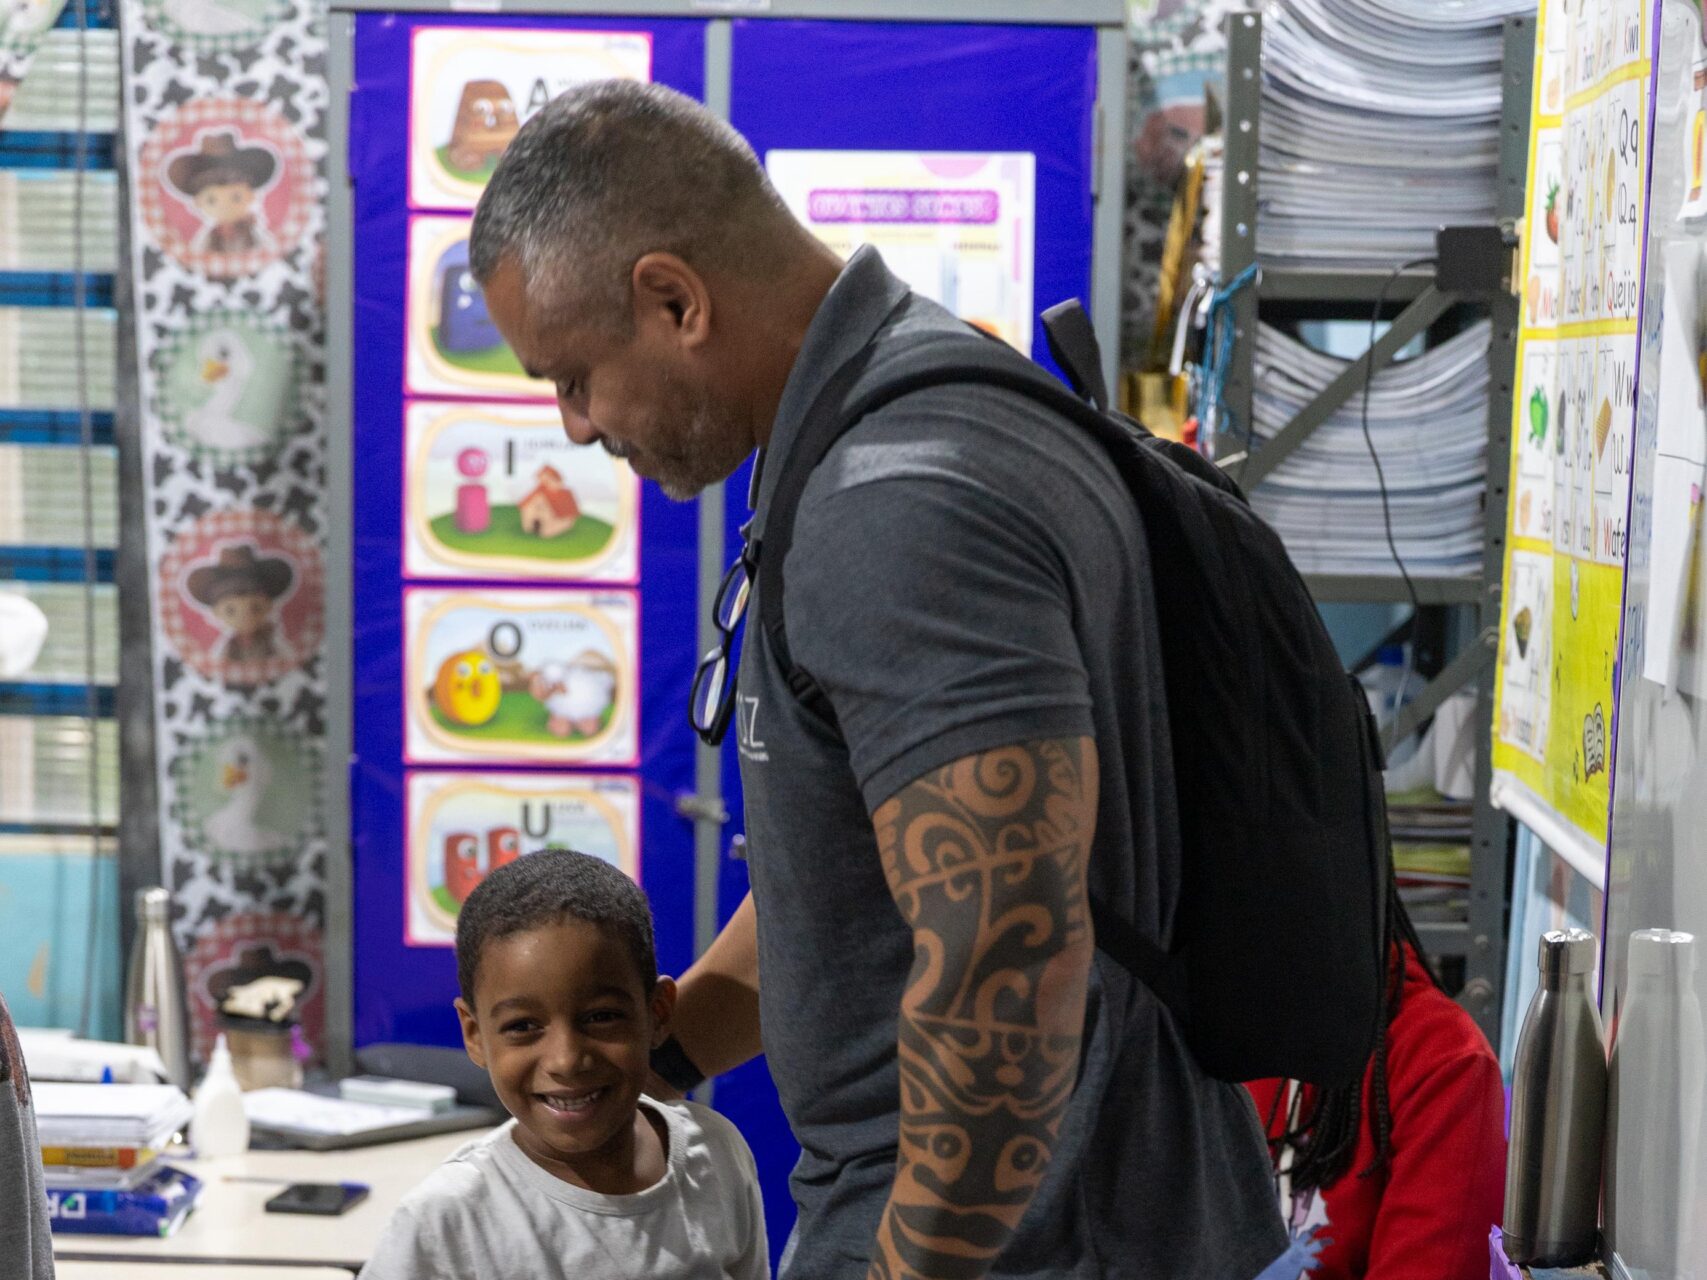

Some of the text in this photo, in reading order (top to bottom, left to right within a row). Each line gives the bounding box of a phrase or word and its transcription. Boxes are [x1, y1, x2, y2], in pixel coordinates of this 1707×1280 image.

[525, 77, 550, 115] A
[1607, 271, 1636, 321] Queijo
[489, 620, 522, 659] O
[522, 803, 551, 838] U
